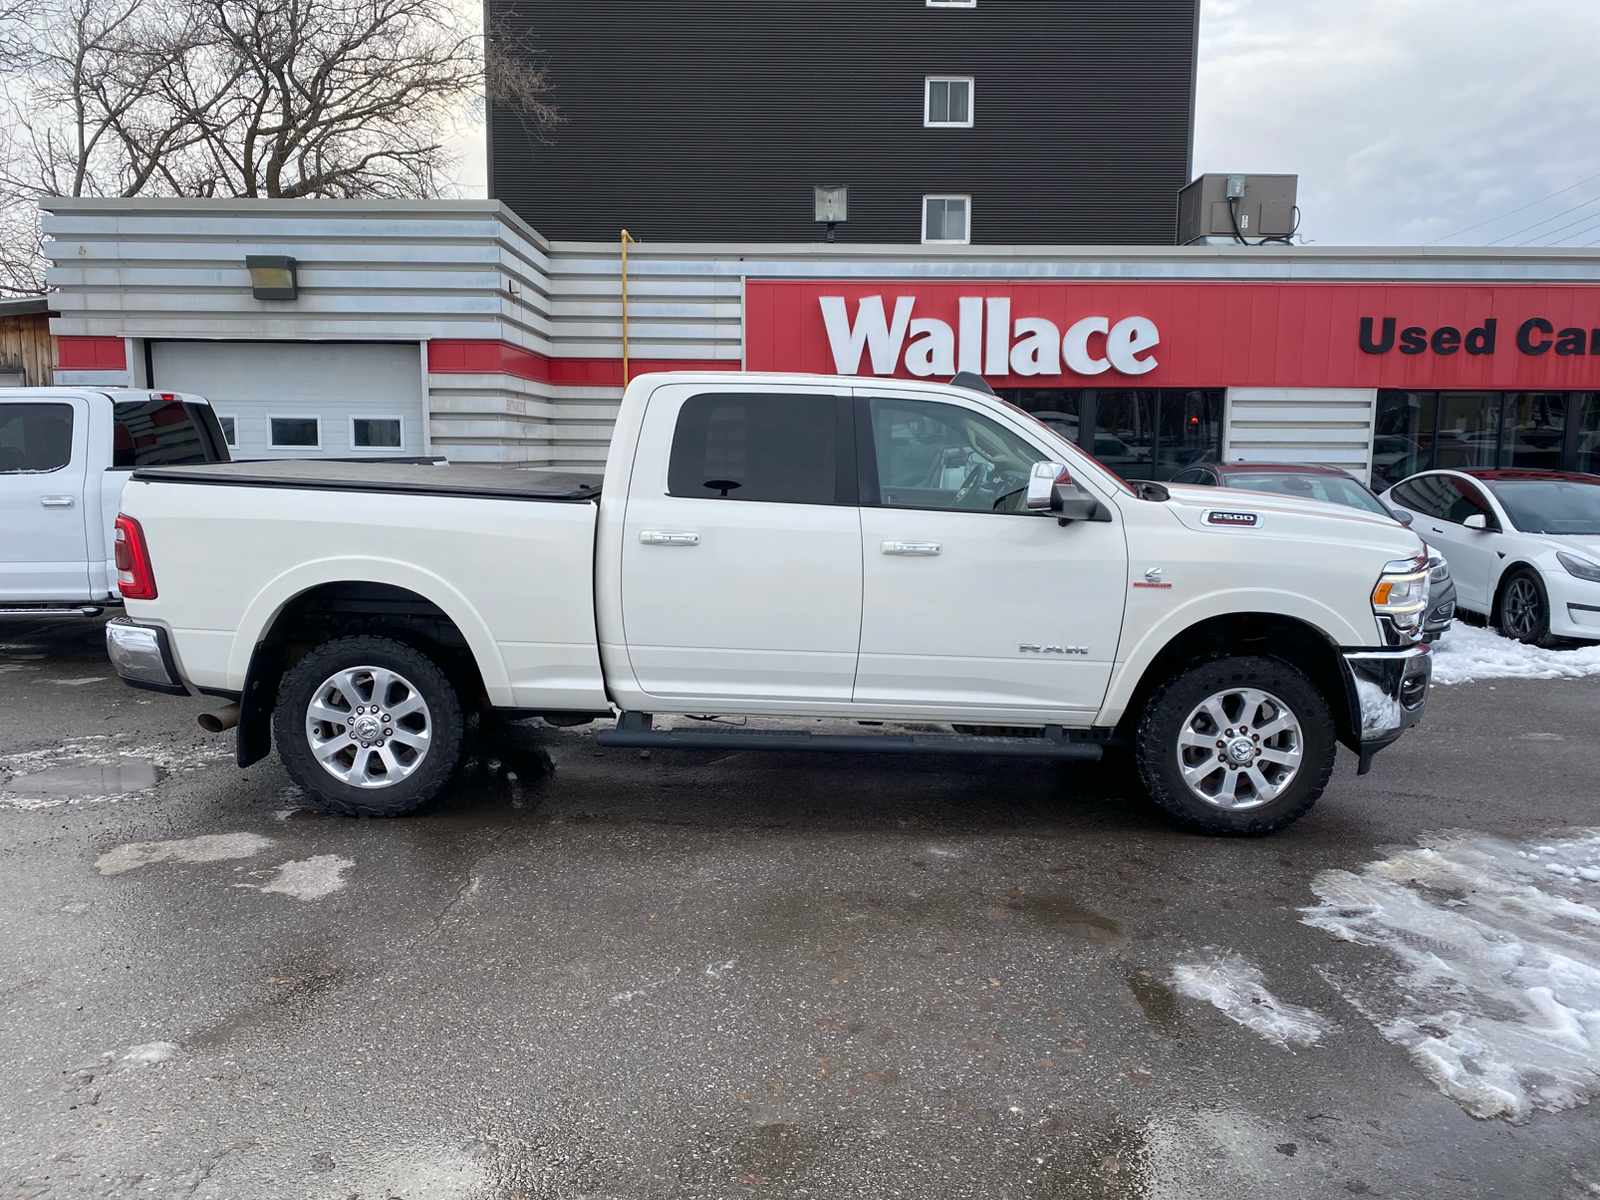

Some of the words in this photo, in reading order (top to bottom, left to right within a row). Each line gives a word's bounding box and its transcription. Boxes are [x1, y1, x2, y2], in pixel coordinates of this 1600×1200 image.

[819, 295, 1160, 377] Wallace
[1359, 317, 1497, 355] Used
[1212, 513, 1254, 521] 2500
[1019, 643, 1088, 655] RAM
